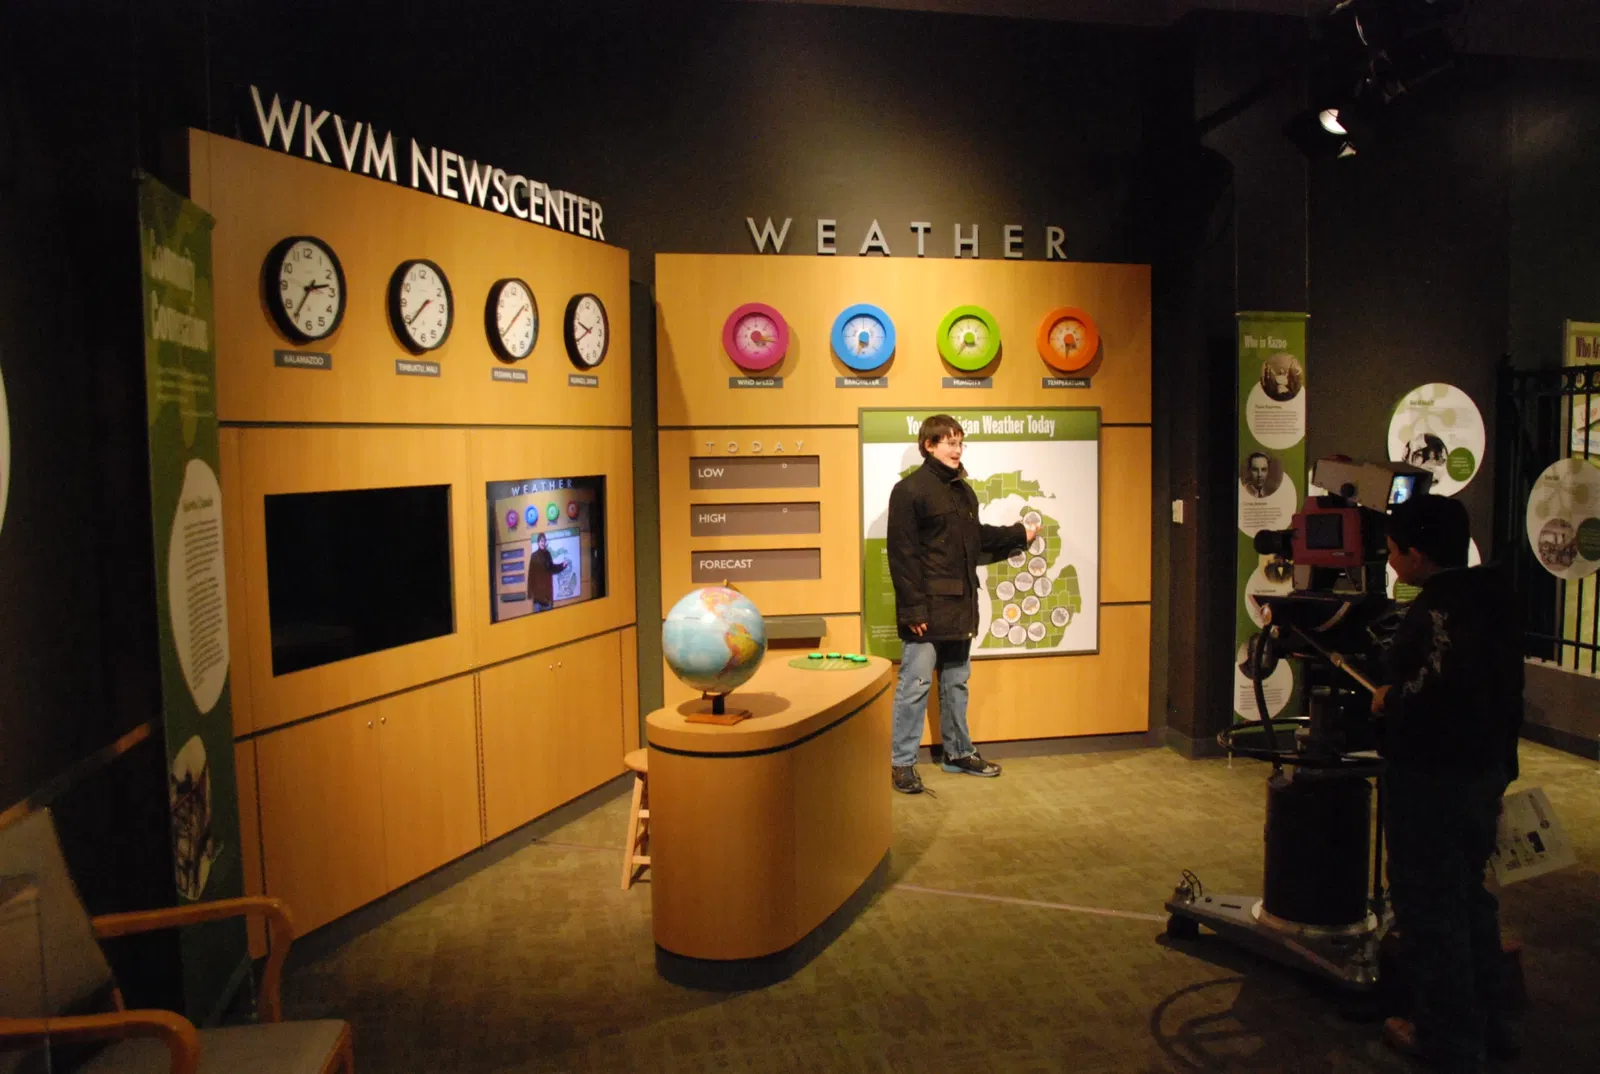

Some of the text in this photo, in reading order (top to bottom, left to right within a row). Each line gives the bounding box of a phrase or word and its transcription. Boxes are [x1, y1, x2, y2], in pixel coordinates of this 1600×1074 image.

[249, 84, 605, 241] WKVM NEWSCENTER
[746, 217, 1067, 260] WEATHER
[293, 250, 300, 262] 11
[303, 248, 313, 259] 12
[283, 262, 293, 274] 10
[325, 269, 332, 280] 2
[281, 280, 289, 291] 9
[328, 287, 336, 299] 3
[285, 298, 293, 309] 8
[325, 304, 332, 313] 4
[305, 319, 313, 331] 6
[318, 316, 325, 327] 5
[283, 354, 325, 366] KALAMAZOO
[982, 415, 1024, 434] Weather
[1027, 415, 1056, 437] Today
[705, 440, 805, 453] TODAY
[698, 468, 724, 478] LOW
[511, 479, 574, 496] WEATHER
[699, 513, 726, 523] HIGH
[700, 559, 754, 570] FORECAST
